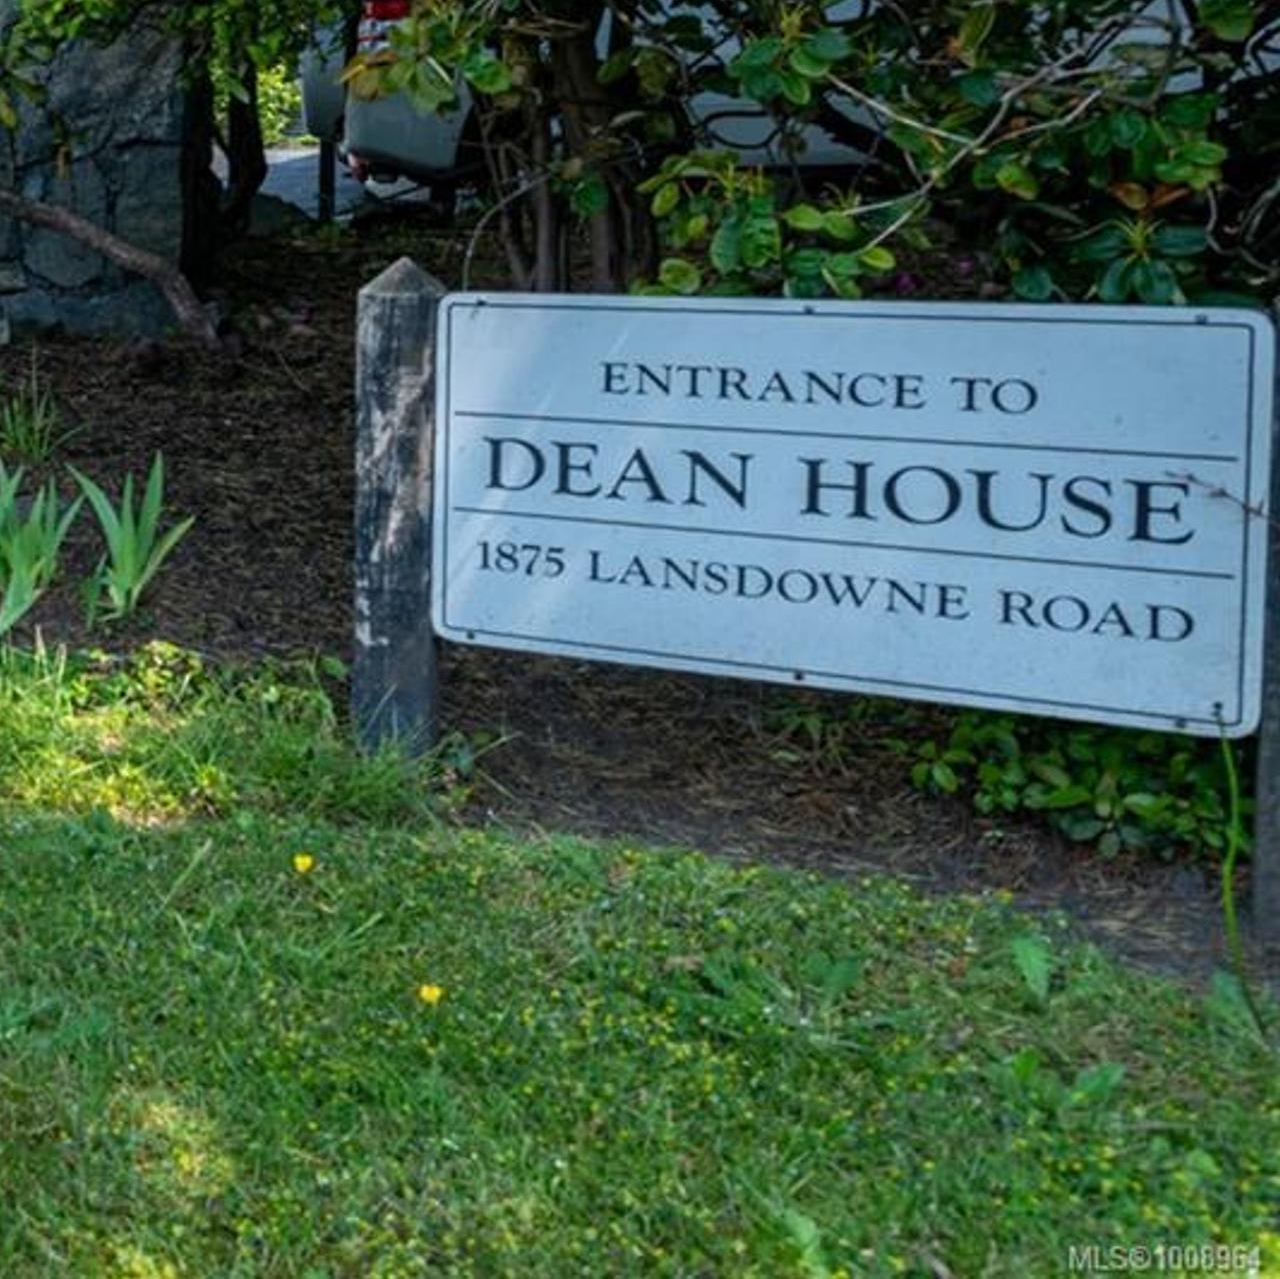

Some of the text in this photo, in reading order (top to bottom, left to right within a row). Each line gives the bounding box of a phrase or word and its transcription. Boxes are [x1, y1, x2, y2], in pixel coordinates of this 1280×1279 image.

[600, 361, 1039, 416] ENTRANCE TO
[483, 436, 1196, 546] DEAN HOUSE
[477, 540, 1196, 643] 1875 LANSDOWNE ROAD
